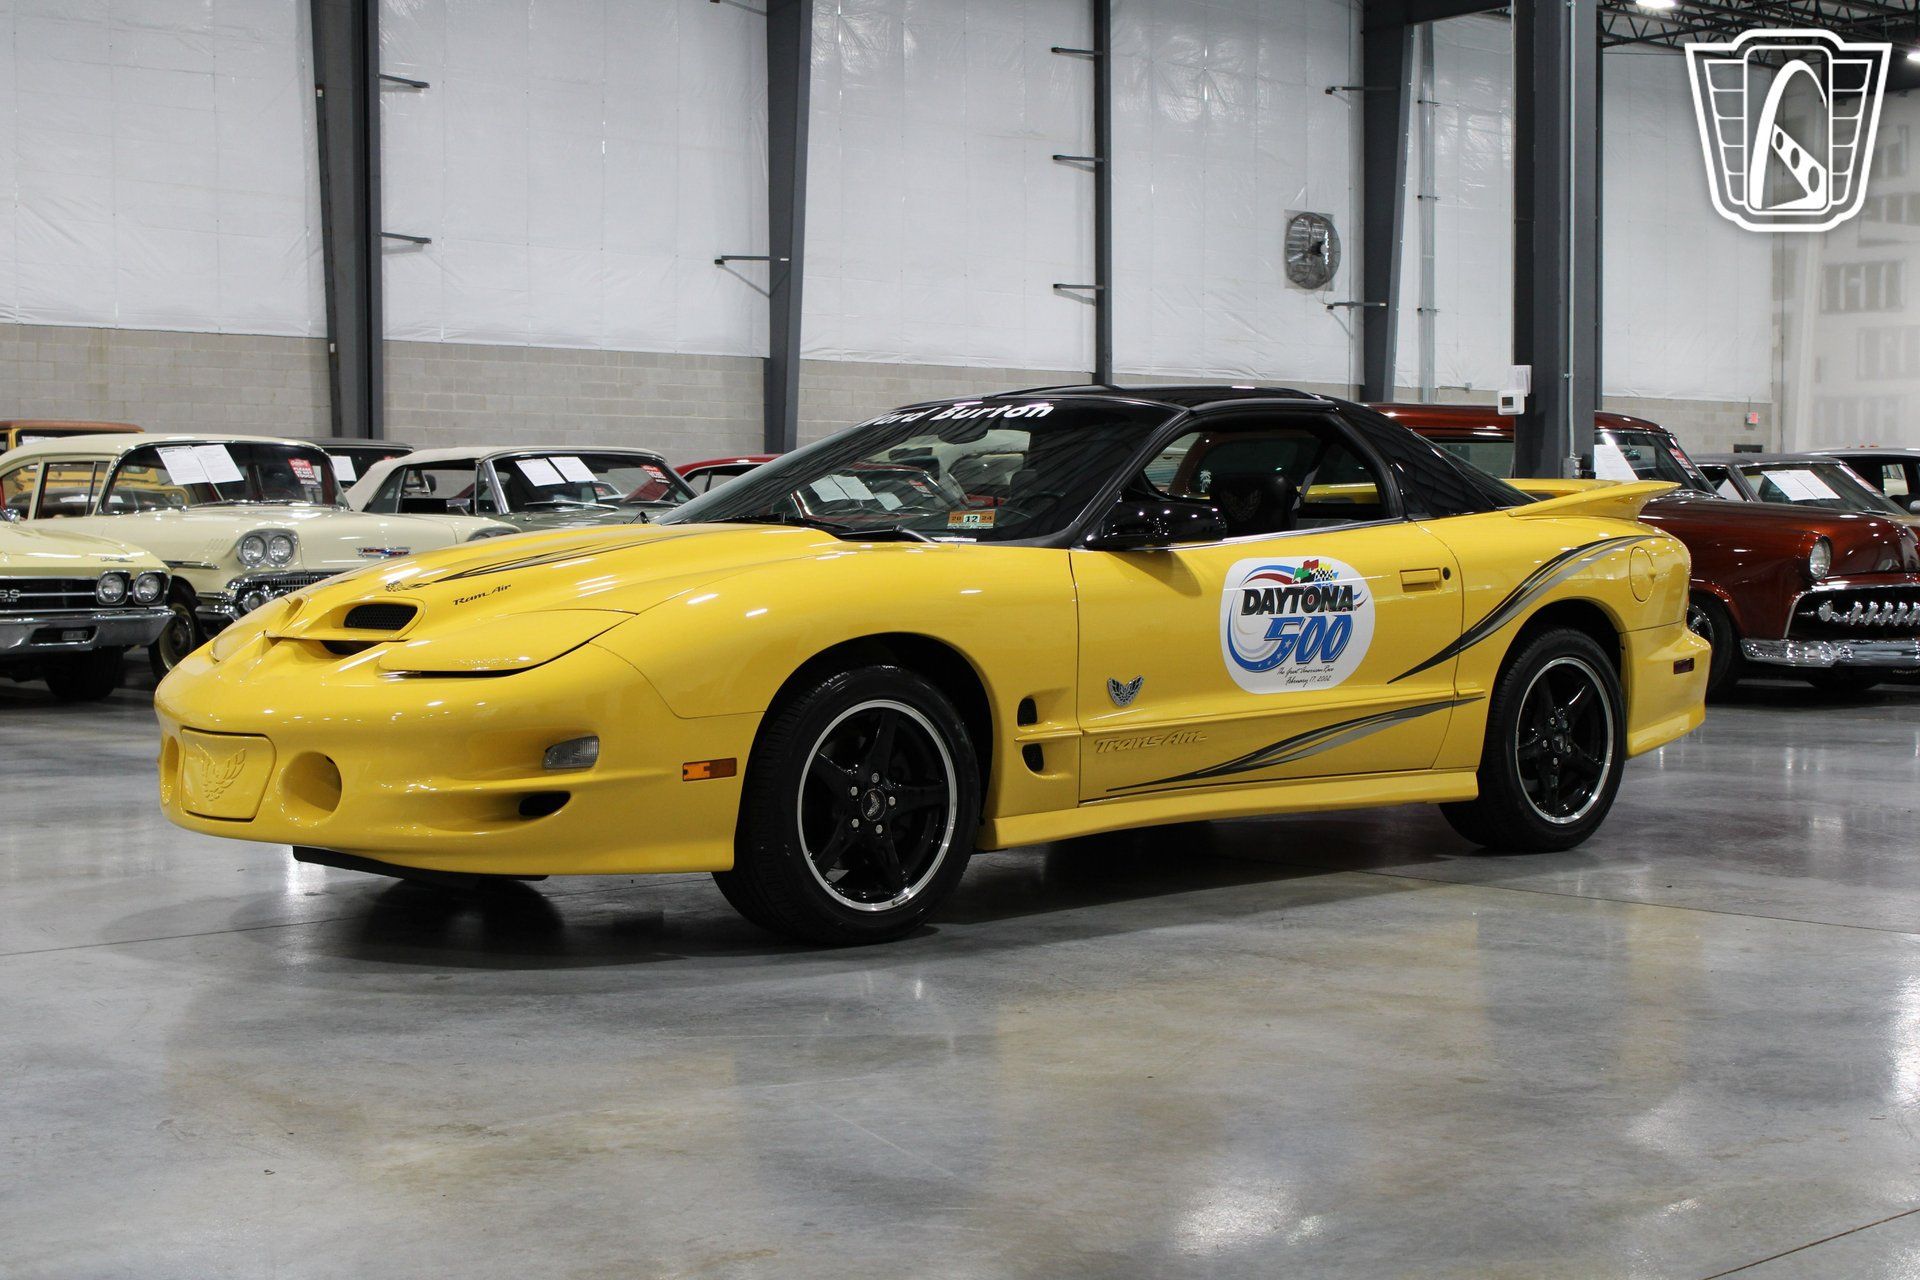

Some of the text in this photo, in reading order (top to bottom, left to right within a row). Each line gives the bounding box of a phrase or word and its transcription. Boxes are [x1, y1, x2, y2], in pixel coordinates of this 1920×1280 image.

[929, 403, 1055, 421] Burton
[0, 589, 21, 599] SS
[453, 584, 512, 605] Ram Air
[1241, 585, 1354, 615] DAYTONA
[1245, 614, 1353, 671] 500
